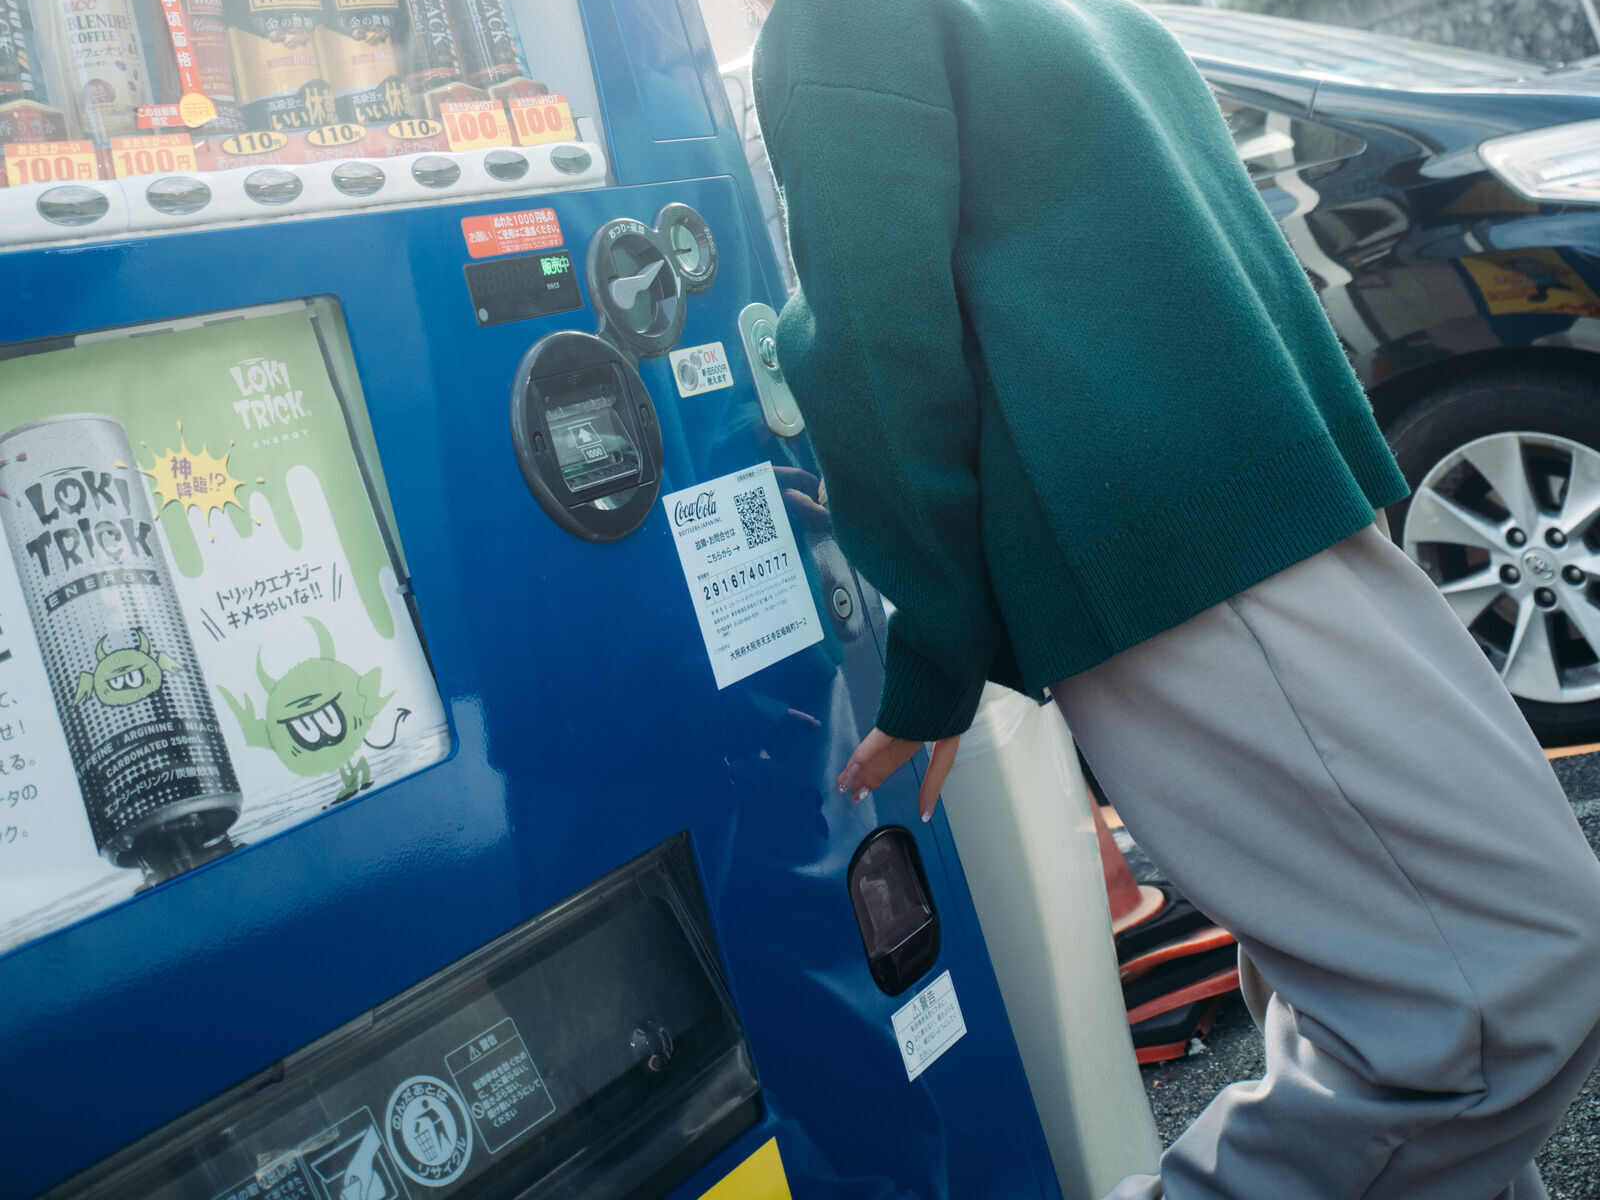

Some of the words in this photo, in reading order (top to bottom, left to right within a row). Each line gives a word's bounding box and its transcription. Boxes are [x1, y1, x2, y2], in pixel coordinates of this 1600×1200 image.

[67, 13, 129, 31] BLENDE
[540, 256, 570, 276] 販売中
[703, 349, 719, 364] OK
[230, 358, 291, 397] LOKI
[232, 390, 306, 430] TRICK
[252, 428, 308, 448] ENERGY
[586, 448, 603, 459] 1000
[170, 455, 192, 480] 神
[25, 470, 132, 527] LOKI
[700, 519, 714, 531] JAPAN
[26, 517, 154, 577] TRICK
[48, 572, 154, 609] ENERGY
[216, 563, 322, 611] トリックエナジー
[123, 720, 175, 744] ARGININE
[185, 720, 221, 733] NIACI
[105, 739, 169, 778] CARBONATED
[171, 735, 205, 746] 250mL
[479, 1033, 498, 1051] 警告
[392, 1083, 449, 1130] のんだあとは
[418, 1136, 466, 1179] リサイクル
